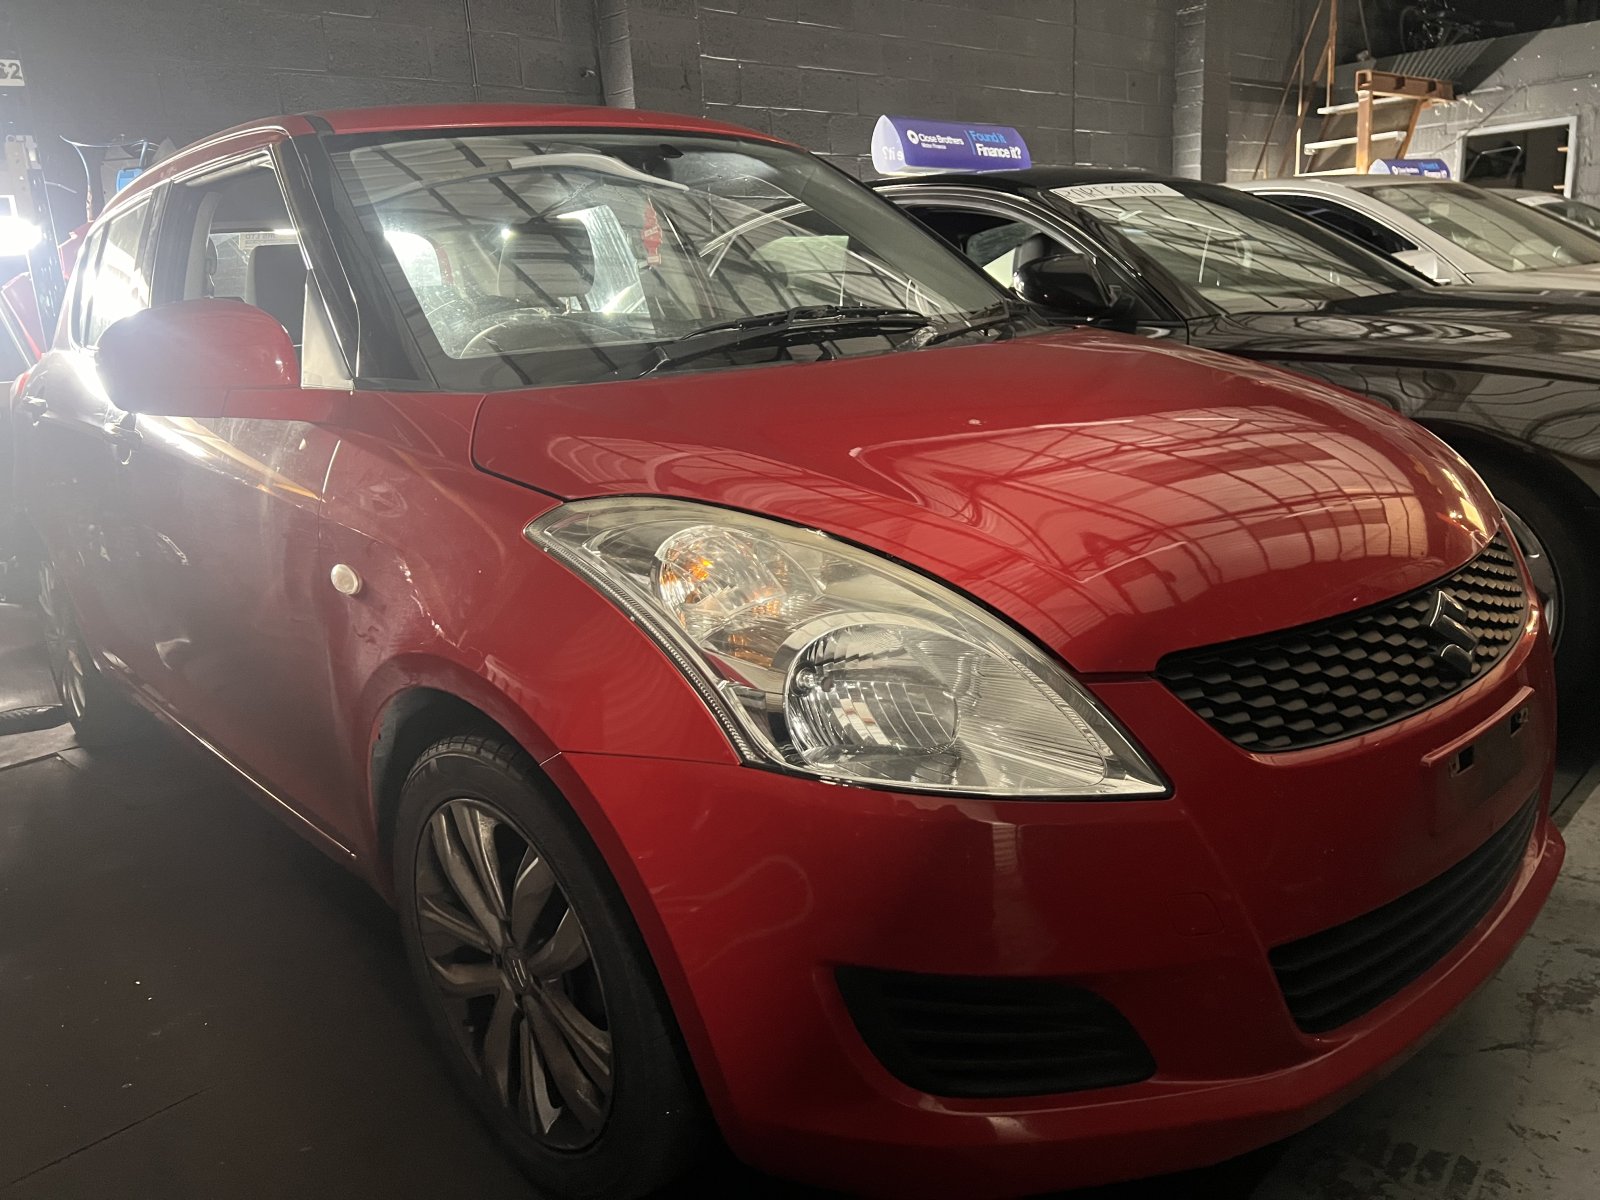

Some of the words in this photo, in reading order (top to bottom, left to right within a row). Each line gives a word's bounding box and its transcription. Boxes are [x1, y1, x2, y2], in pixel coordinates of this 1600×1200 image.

[918, 133, 937, 143] Close
[936, 135, 964, 145] Brothers
[969, 130, 998, 143] Found
[998, 133, 1007, 144] it
[975, 143, 1010, 158] Finance
[1009, 146, 1022, 159] it?
